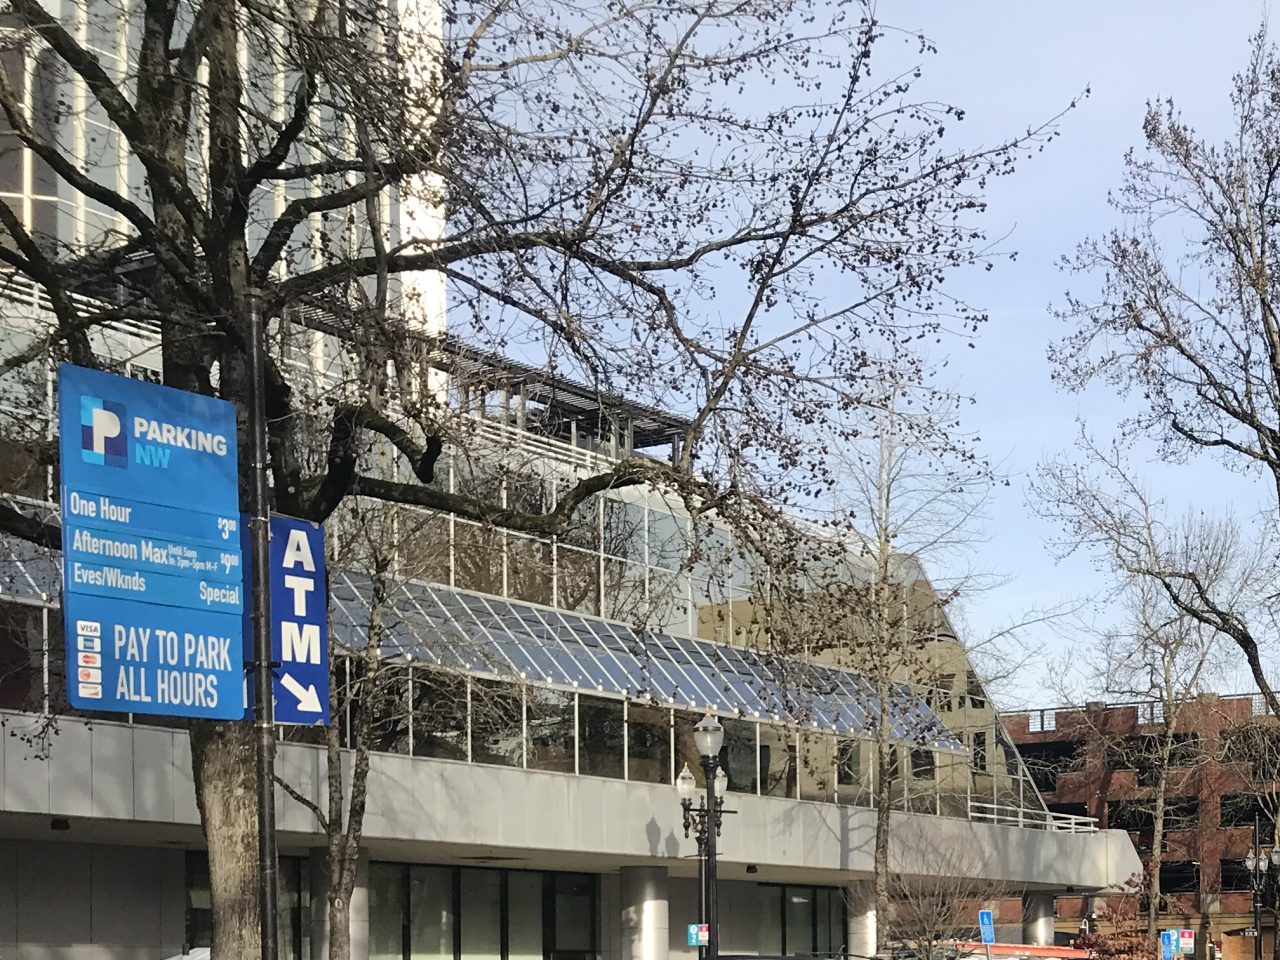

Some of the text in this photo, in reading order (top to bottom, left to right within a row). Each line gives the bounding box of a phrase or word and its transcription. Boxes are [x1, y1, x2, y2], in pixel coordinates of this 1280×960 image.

[133, 416, 228, 456] PARKING
[135, 442, 171, 469] NW
[70, 491, 132, 523] One Hour
[72, 528, 169, 565] Afternoon Max
[73, 561, 147, 592] Eves/Wknds
[199, 580, 240, 606] Special
[281, 528, 322, 666] ATM
[80, 623, 99, 634] VISA
[114, 623, 232, 672] PAY TO PARK
[116, 665, 218, 709] ALL HOURS
